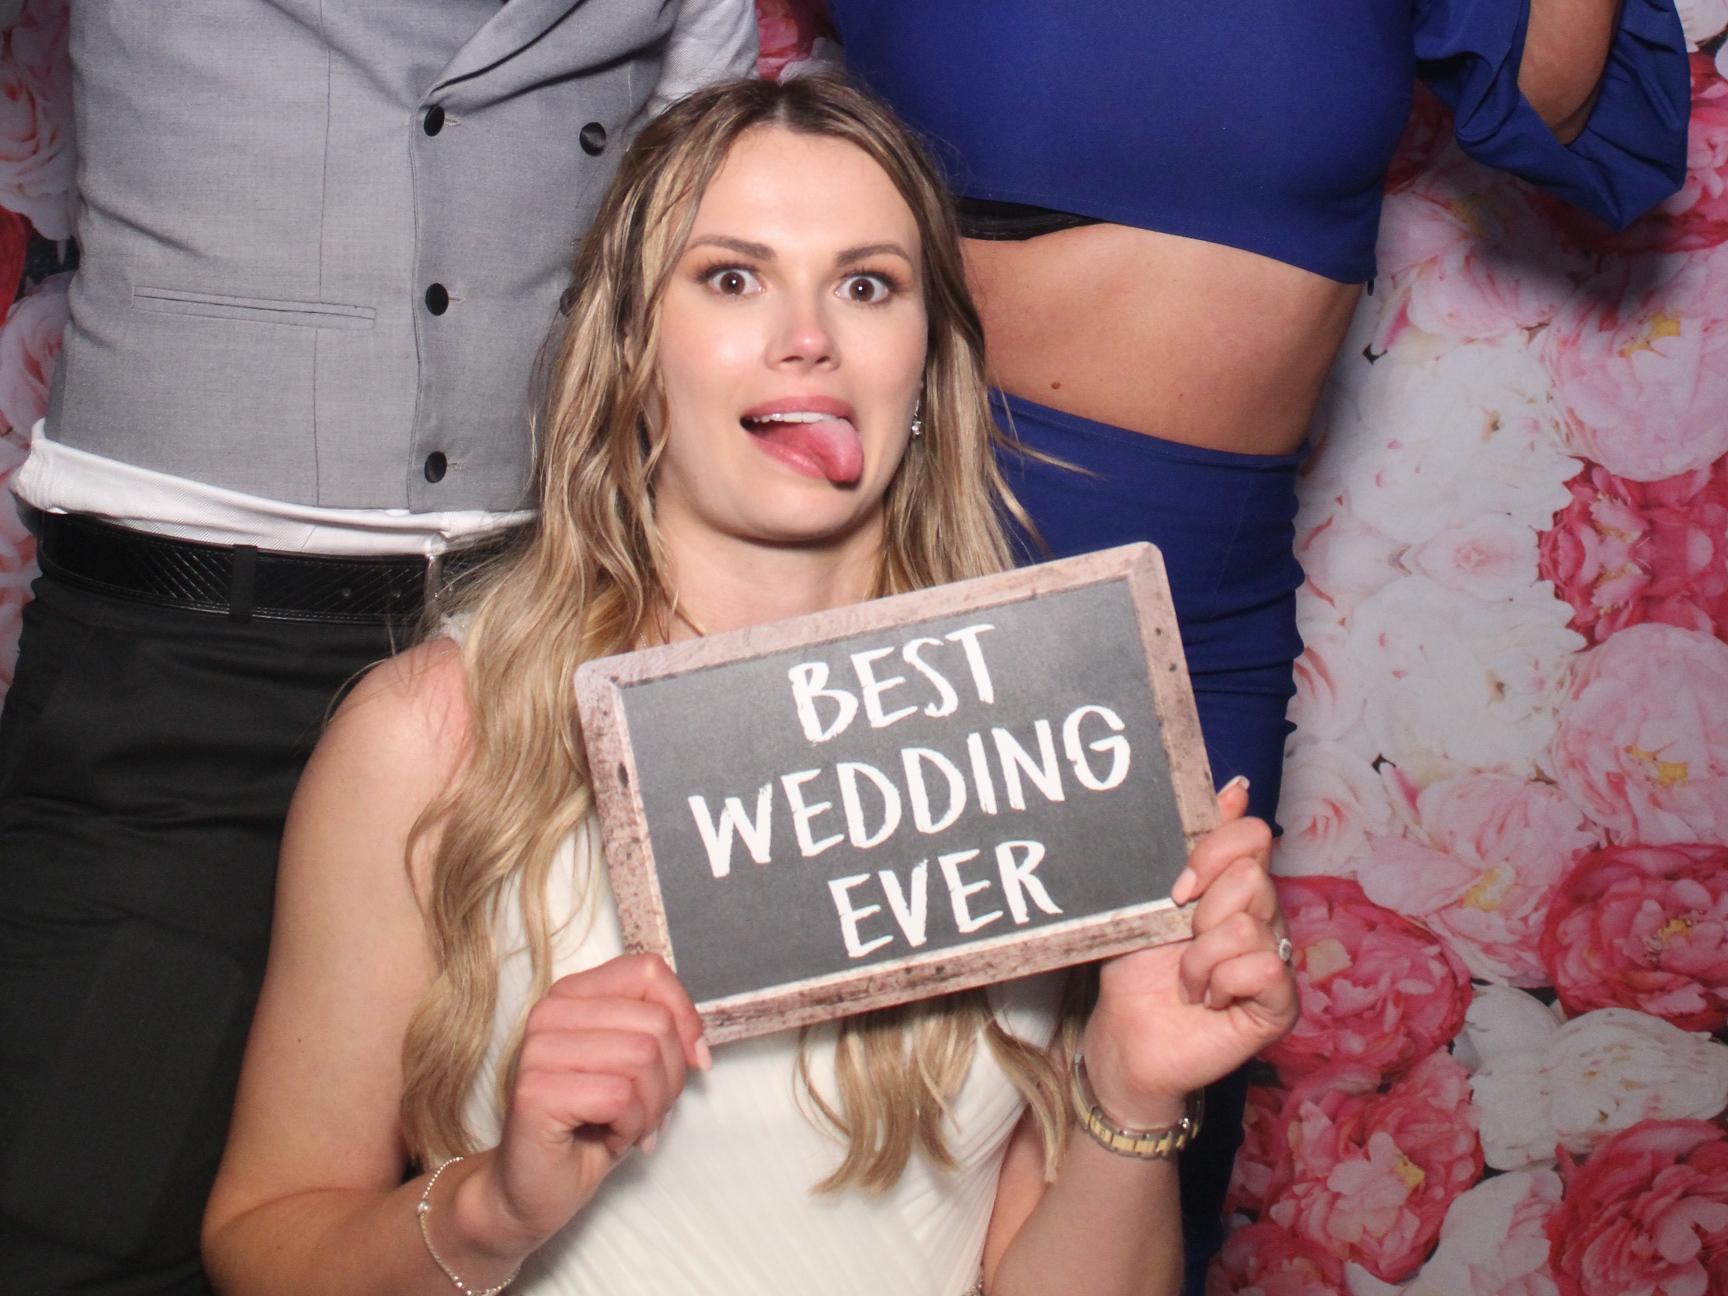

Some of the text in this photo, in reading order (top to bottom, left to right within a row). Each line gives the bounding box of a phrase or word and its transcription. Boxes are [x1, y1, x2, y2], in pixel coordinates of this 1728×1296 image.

[788, 624, 994, 744] BEST
[688, 705, 1131, 878] WEDDING
[828, 840, 1063, 958] EVER
